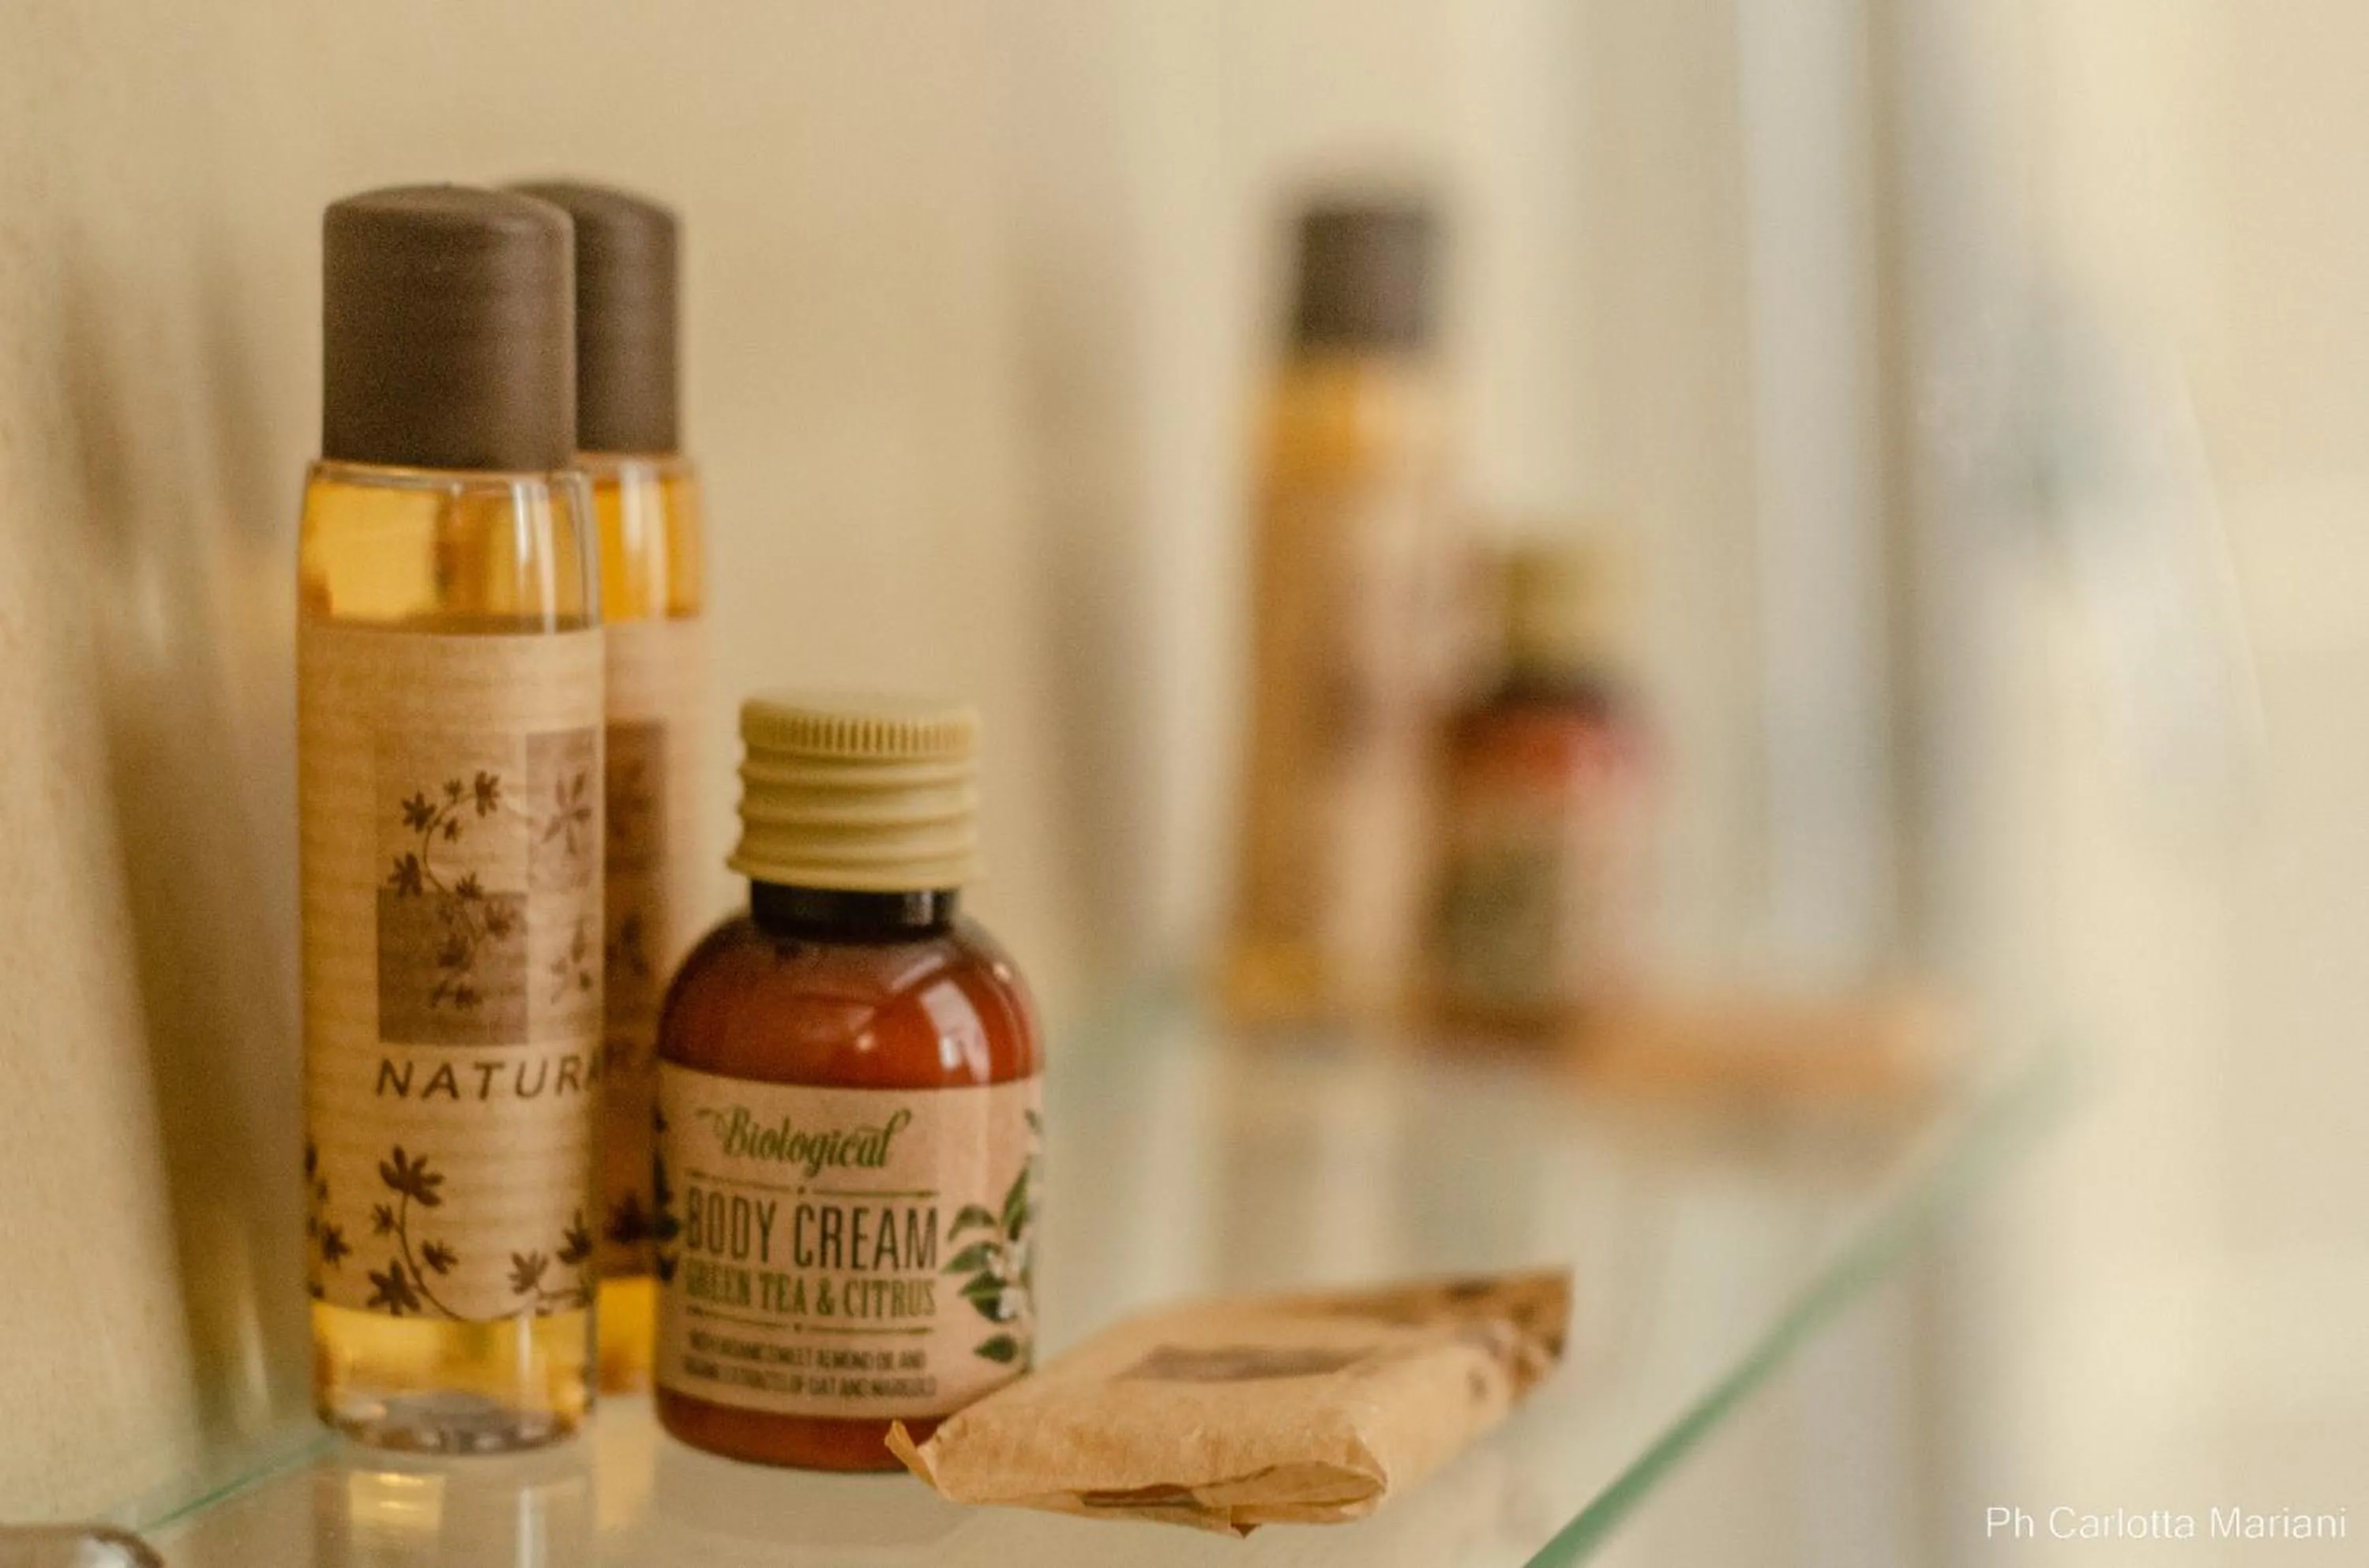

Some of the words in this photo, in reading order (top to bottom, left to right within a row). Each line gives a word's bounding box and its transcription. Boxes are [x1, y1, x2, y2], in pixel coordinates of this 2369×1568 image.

[695, 1106, 913, 1178] Biological
[686, 1186, 777, 1263] BODY
[794, 1202, 938, 1272] CREAM
[758, 1272, 808, 1315] TEA
[816, 1277, 836, 1317] &
[843, 1278, 937, 1319] CITRUS
